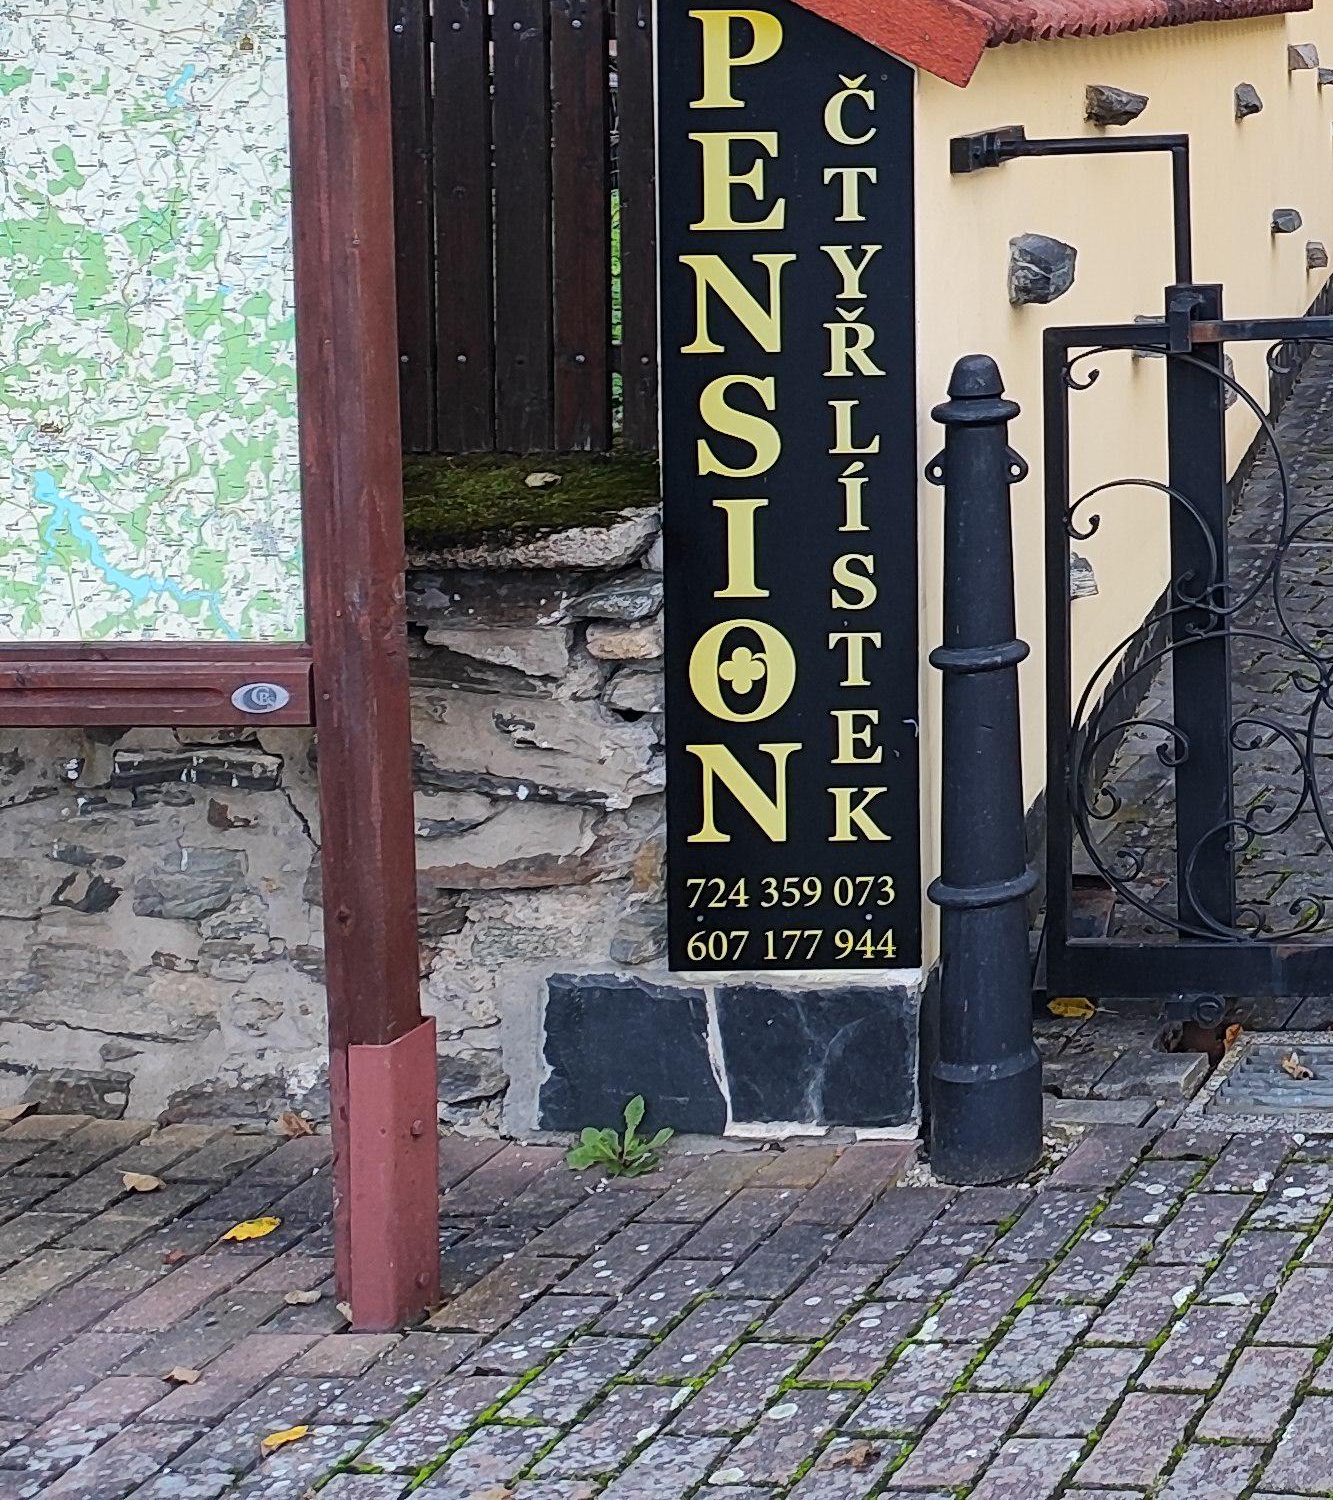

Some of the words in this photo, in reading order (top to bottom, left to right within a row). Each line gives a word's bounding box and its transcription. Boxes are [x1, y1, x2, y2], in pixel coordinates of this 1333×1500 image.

[680, 8, 801, 843] PENSION
[822, 74, 890, 843] ČTYŘLÍSTEK
[686, 877, 750, 908] 724
[760, 876, 822, 908] 359
[833, 875, 896, 907] 073
[687, 930, 750, 961] 607
[763, 929, 824, 960] 177
[834, 928, 897, 959] 944
